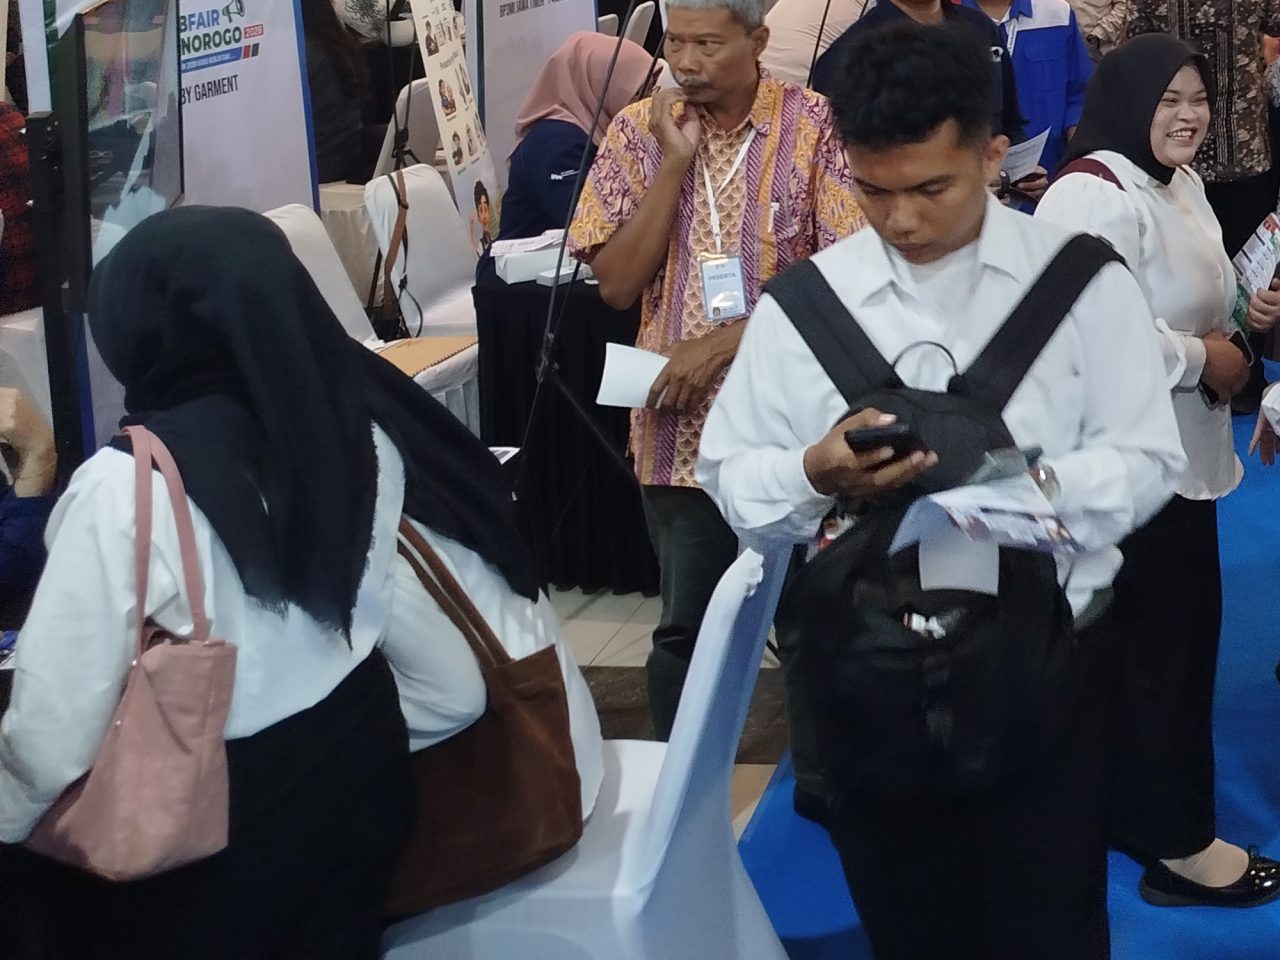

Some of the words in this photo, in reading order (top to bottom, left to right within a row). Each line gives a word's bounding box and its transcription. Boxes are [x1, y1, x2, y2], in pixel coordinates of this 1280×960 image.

[180, 9, 220, 33] BFAIR
[181, 26, 242, 55] NOROGO
[194, 74, 239, 102] GARMENT
